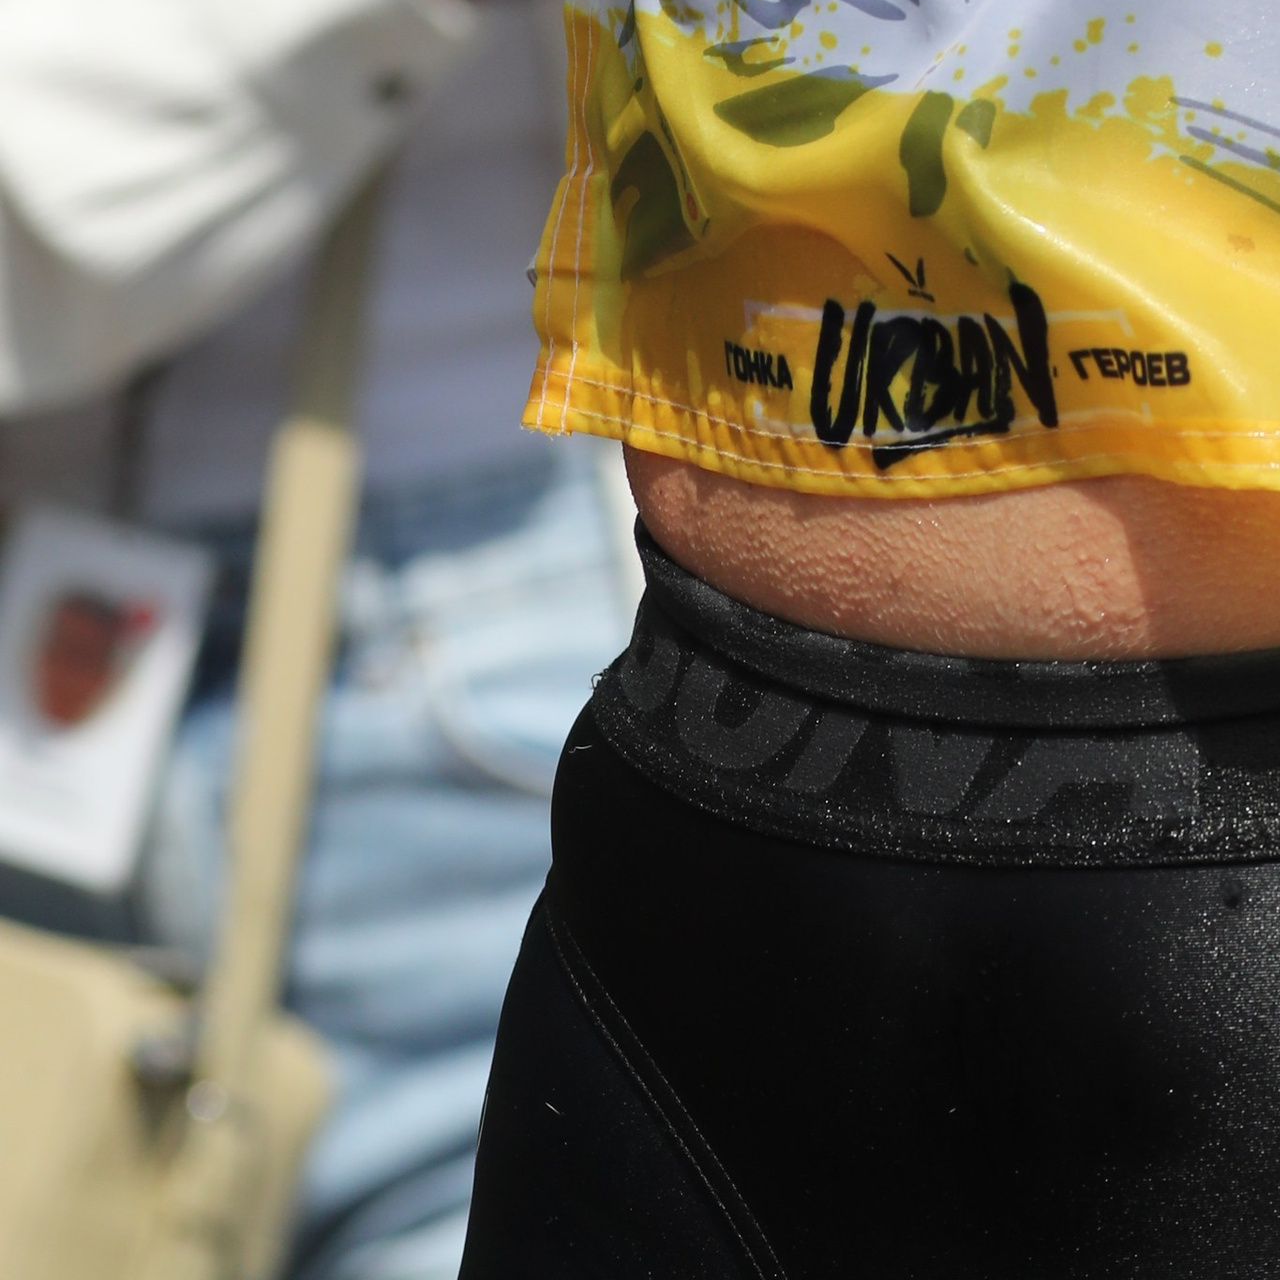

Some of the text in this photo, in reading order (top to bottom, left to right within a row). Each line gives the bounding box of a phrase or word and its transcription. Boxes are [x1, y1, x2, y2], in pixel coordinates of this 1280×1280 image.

[724, 280, 1191, 448] ГОНКА URBAN ГЕРОЕВ
